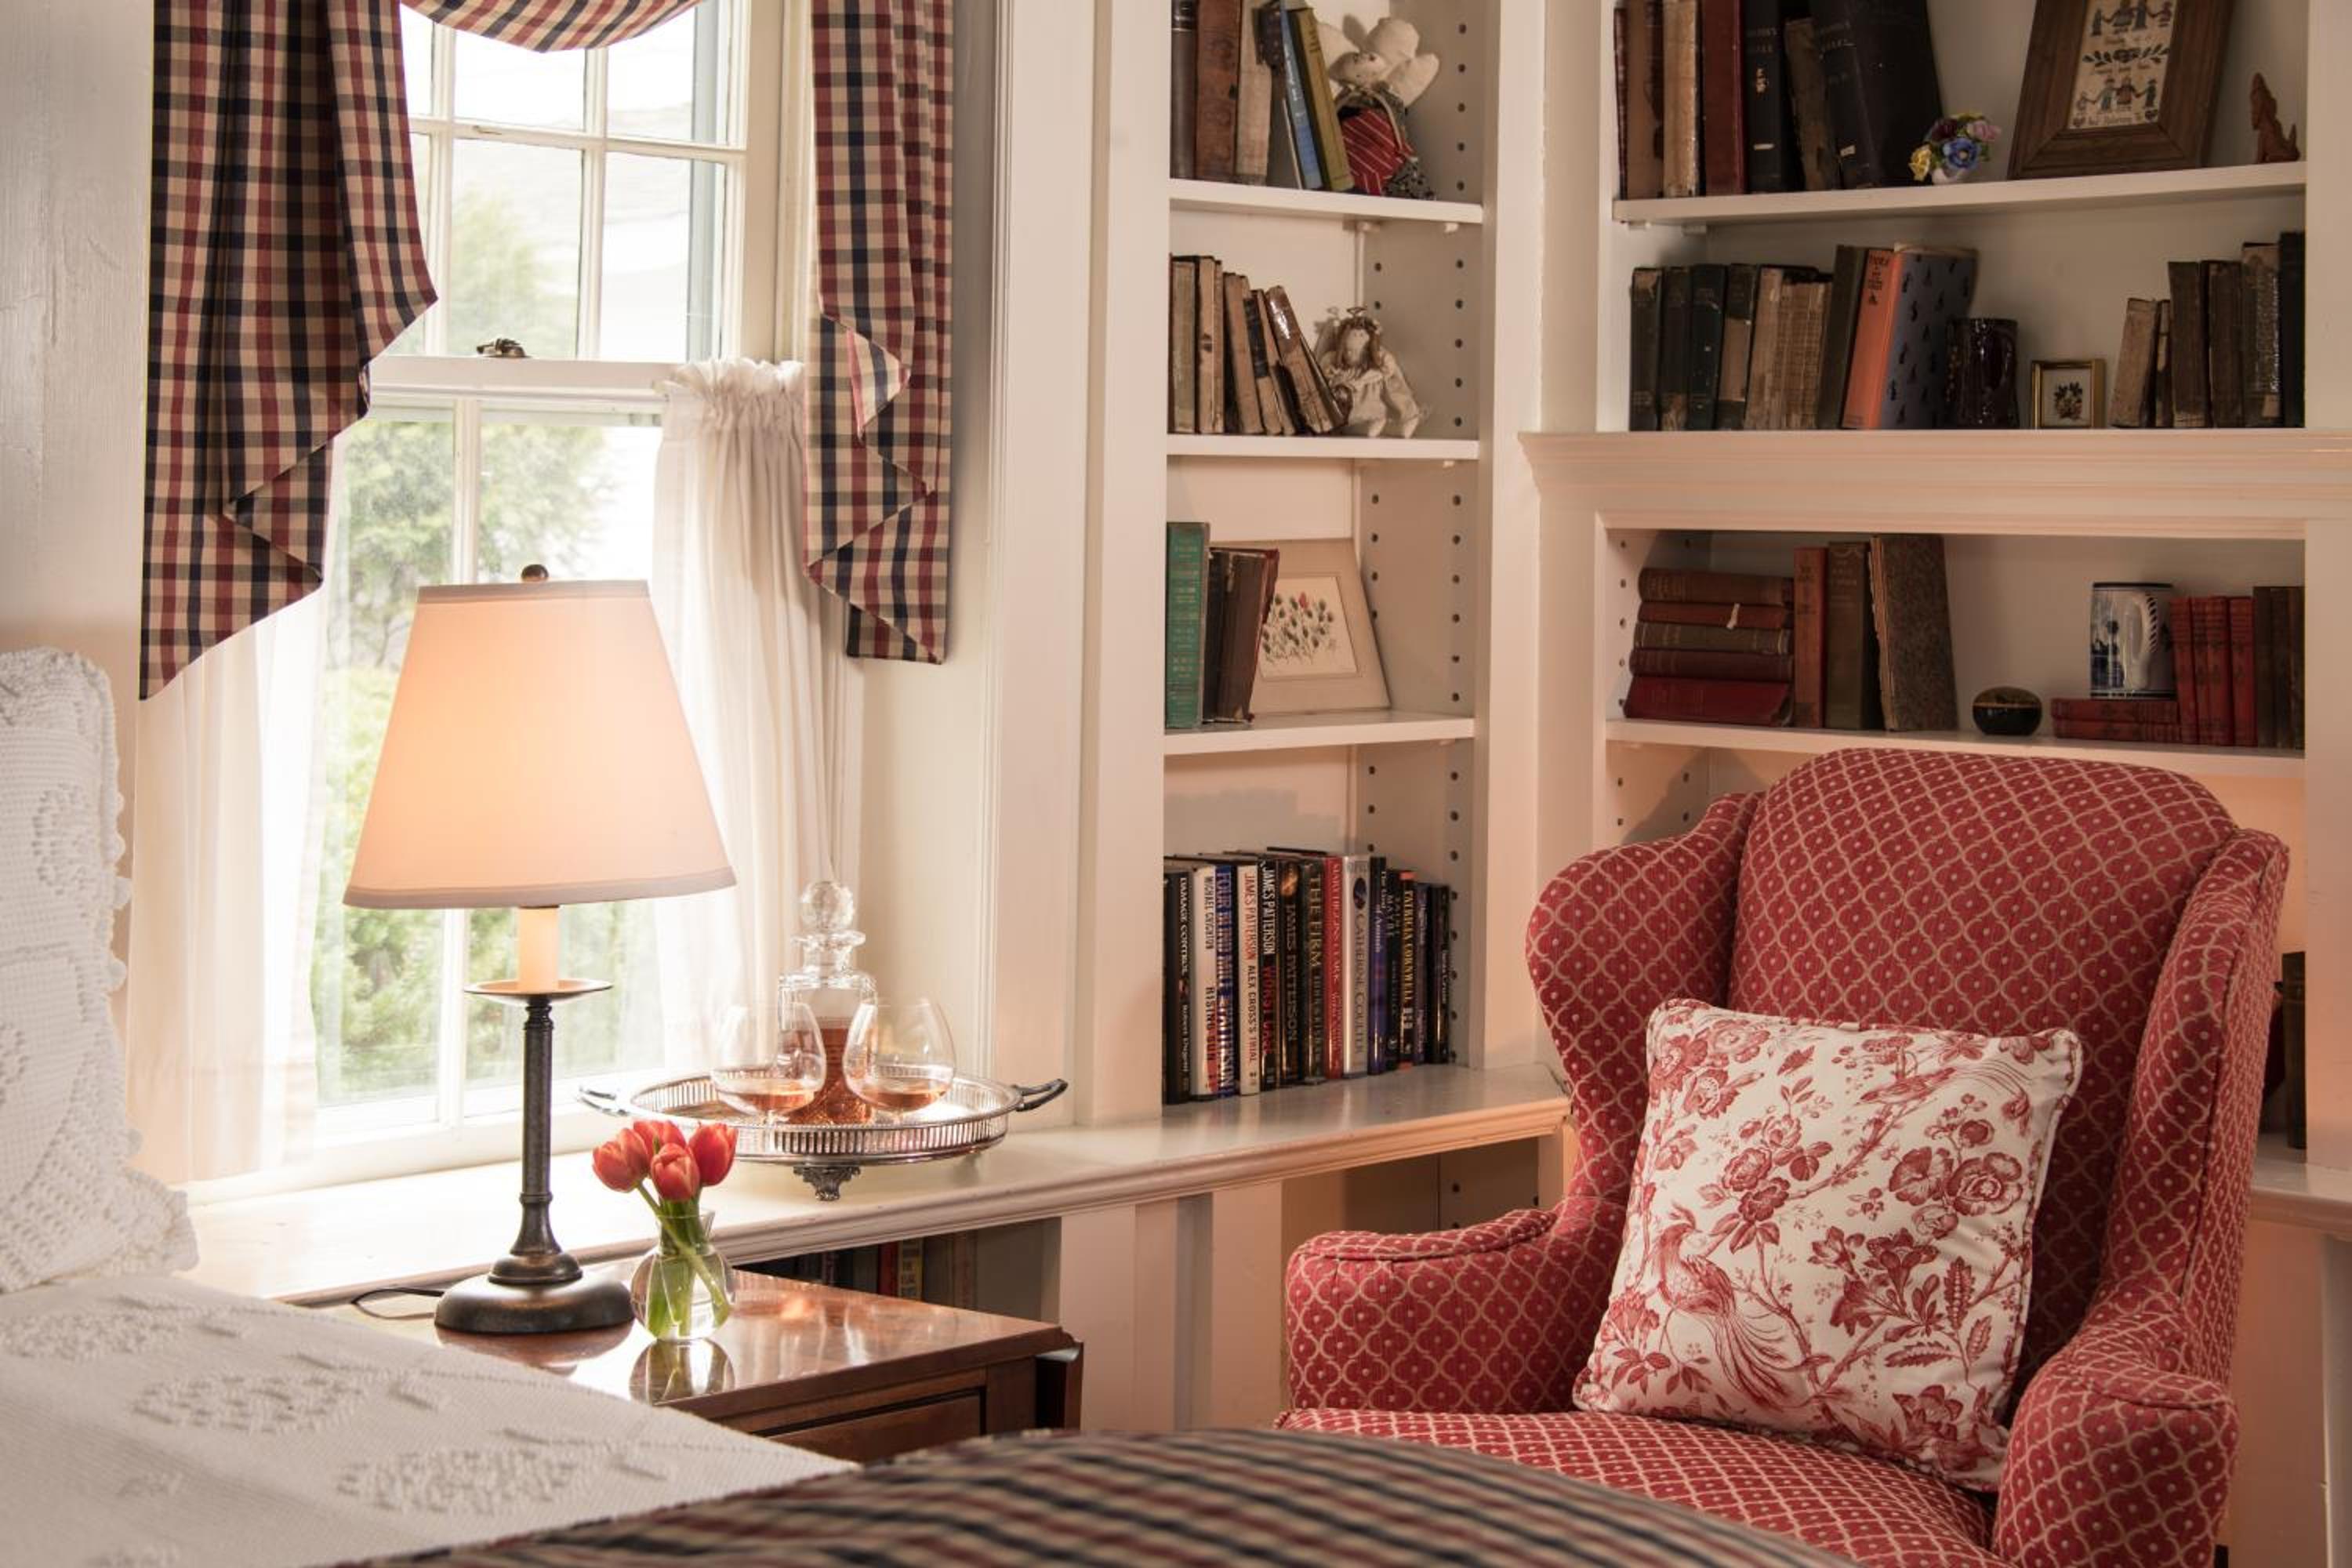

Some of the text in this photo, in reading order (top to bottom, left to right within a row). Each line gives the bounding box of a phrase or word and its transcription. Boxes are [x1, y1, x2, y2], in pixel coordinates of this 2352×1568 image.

[1217, 873, 1232, 909] FOUR
[1244, 873, 1257, 905] JAMES
[1262, 867, 1276, 899] JAMES
[1310, 877, 1322, 916] THE
[1244, 906, 1257, 960] PATTERSON
[1262, 900, 1276, 954] PATTERSON
[1309, 921, 1322, 967] FIRM
[1355, 913, 1366, 987] CATHERINE
[1247, 965, 1257, 989] ALEX
[1286, 954, 1298, 1041] PATTERSON
